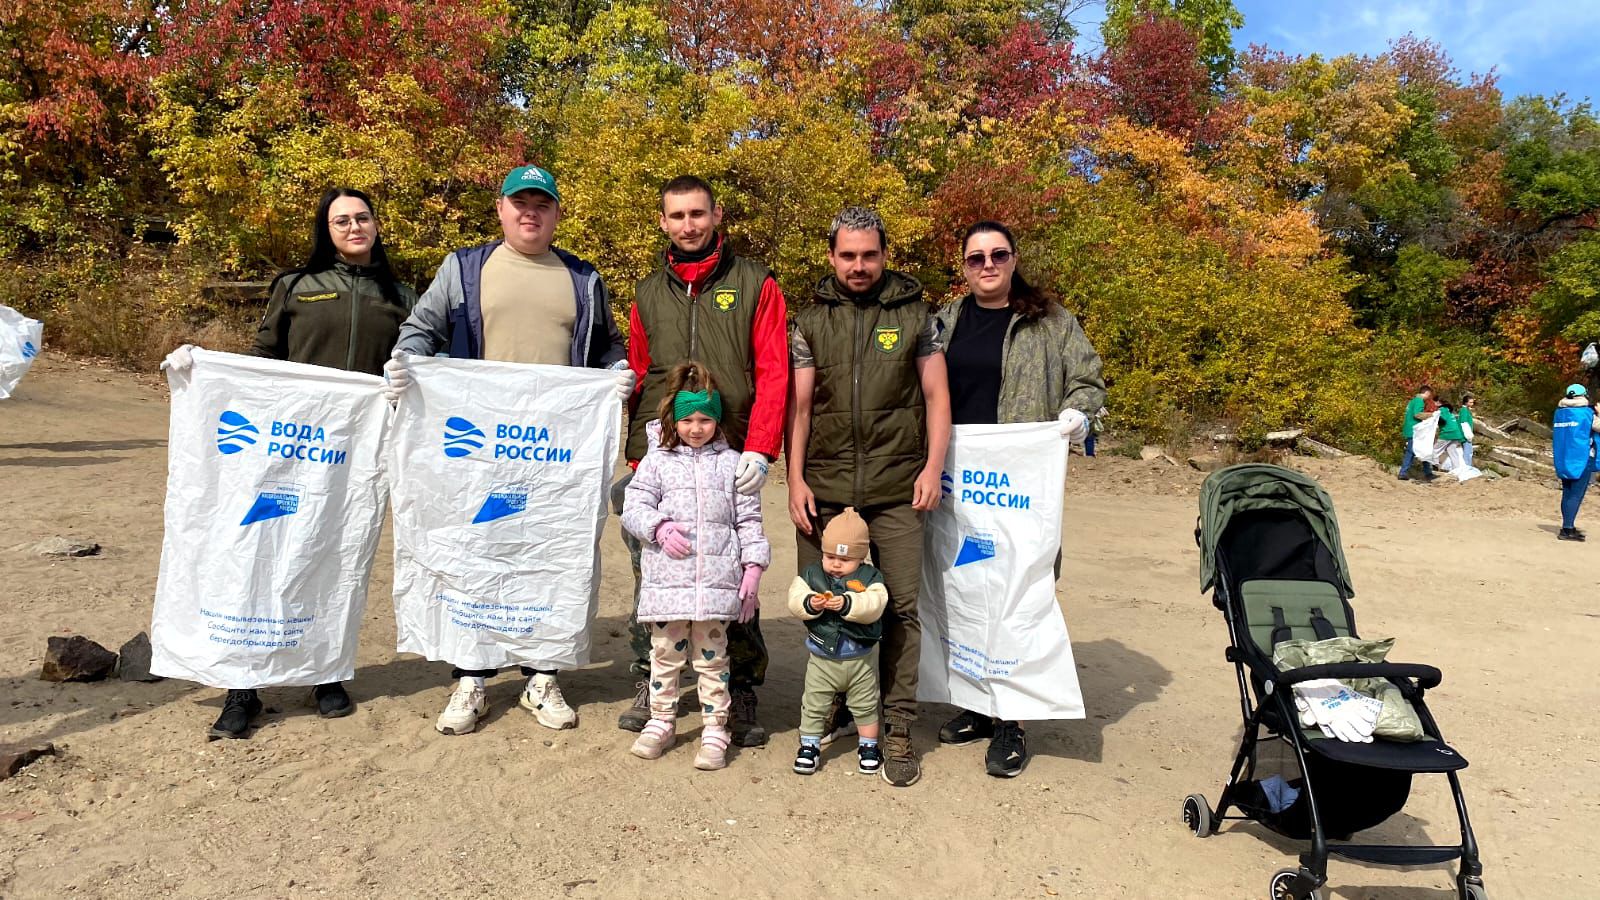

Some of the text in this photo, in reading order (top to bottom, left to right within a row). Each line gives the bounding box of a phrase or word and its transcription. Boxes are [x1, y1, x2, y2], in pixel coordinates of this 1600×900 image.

[271, 421, 325, 442] ВОДА
[496, 424, 549, 443] ВОДА
[267, 442, 347, 464] РОССИИ
[494, 444, 571, 463] РОССИИ
[962, 470, 1010, 489] ВОДА
[961, 489, 1030, 510] РОССИИ
[249, 628, 267, 636] нам
[283, 626, 304, 636] сайте
